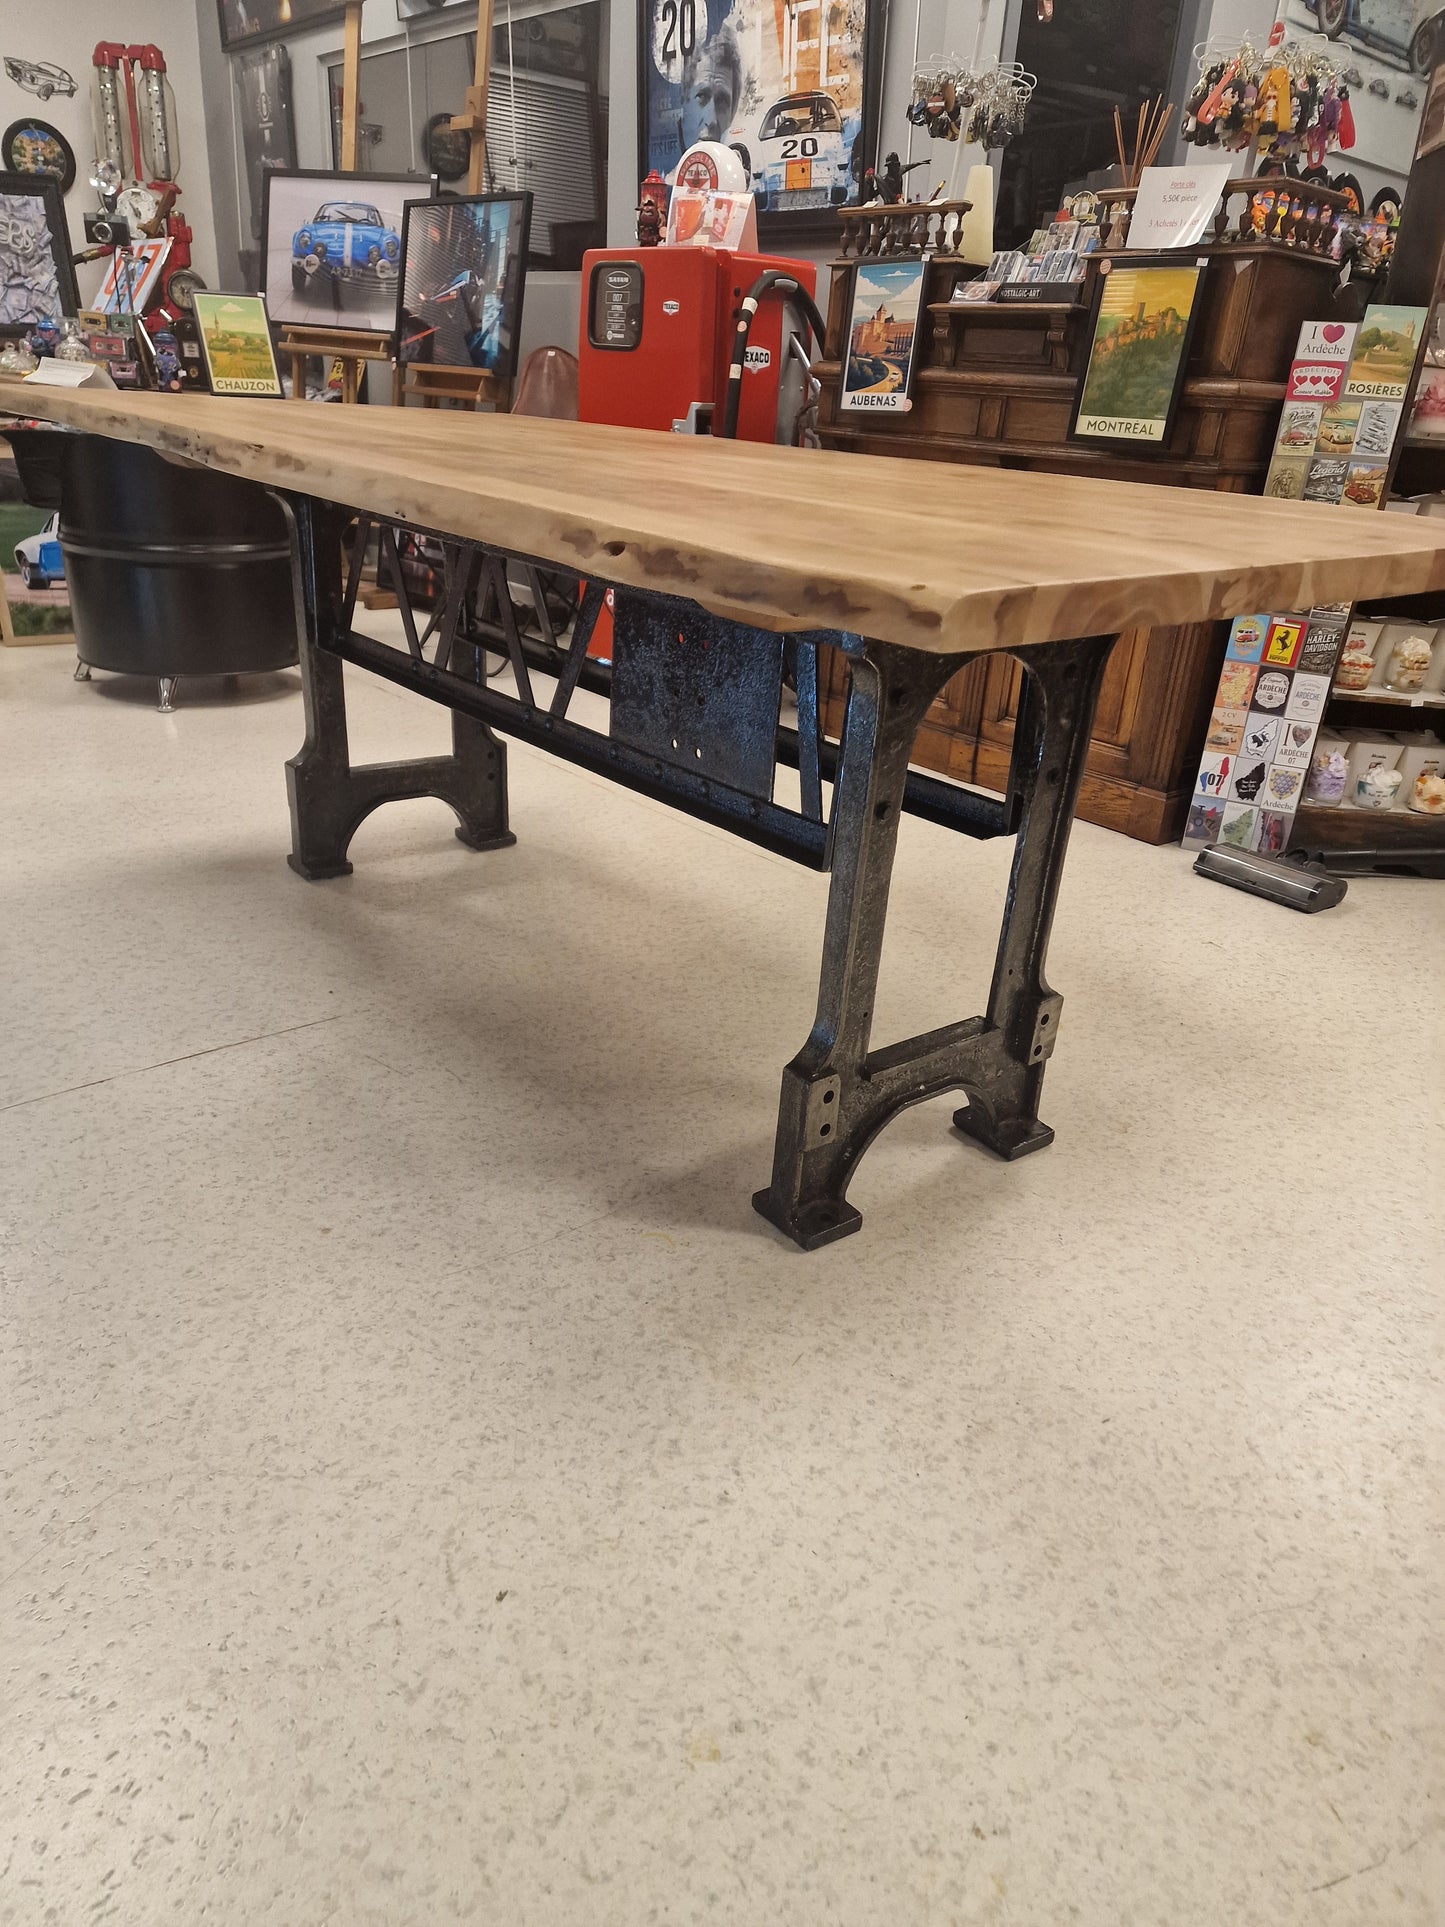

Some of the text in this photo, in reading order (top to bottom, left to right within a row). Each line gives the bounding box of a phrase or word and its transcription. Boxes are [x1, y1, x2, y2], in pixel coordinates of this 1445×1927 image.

[662, 0, 696, 61] 20
[781, 138, 818, 159] 20
[1311, 325, 1318, 339] I
[1303, 343, 1346, 355] Ardèche
[745, 351, 770, 364] EXACO
[215, 379, 276, 391] CHAUZON
[1348, 382, 1403, 397] ROSIÈRES
[850, 395, 897, 407] AUBENAS
[1086, 419, 1154, 436] MONTRÉAL
[1310, 463, 1347, 476] Legend
[1306, 633, 1341, 644] HARLEY-
[1303, 642, 1338, 653] DAVIDSON
[1283, 723, 1291, 746] I
[1288, 757, 1296, 765] 07
[1207, 773, 1223, 787] 07
